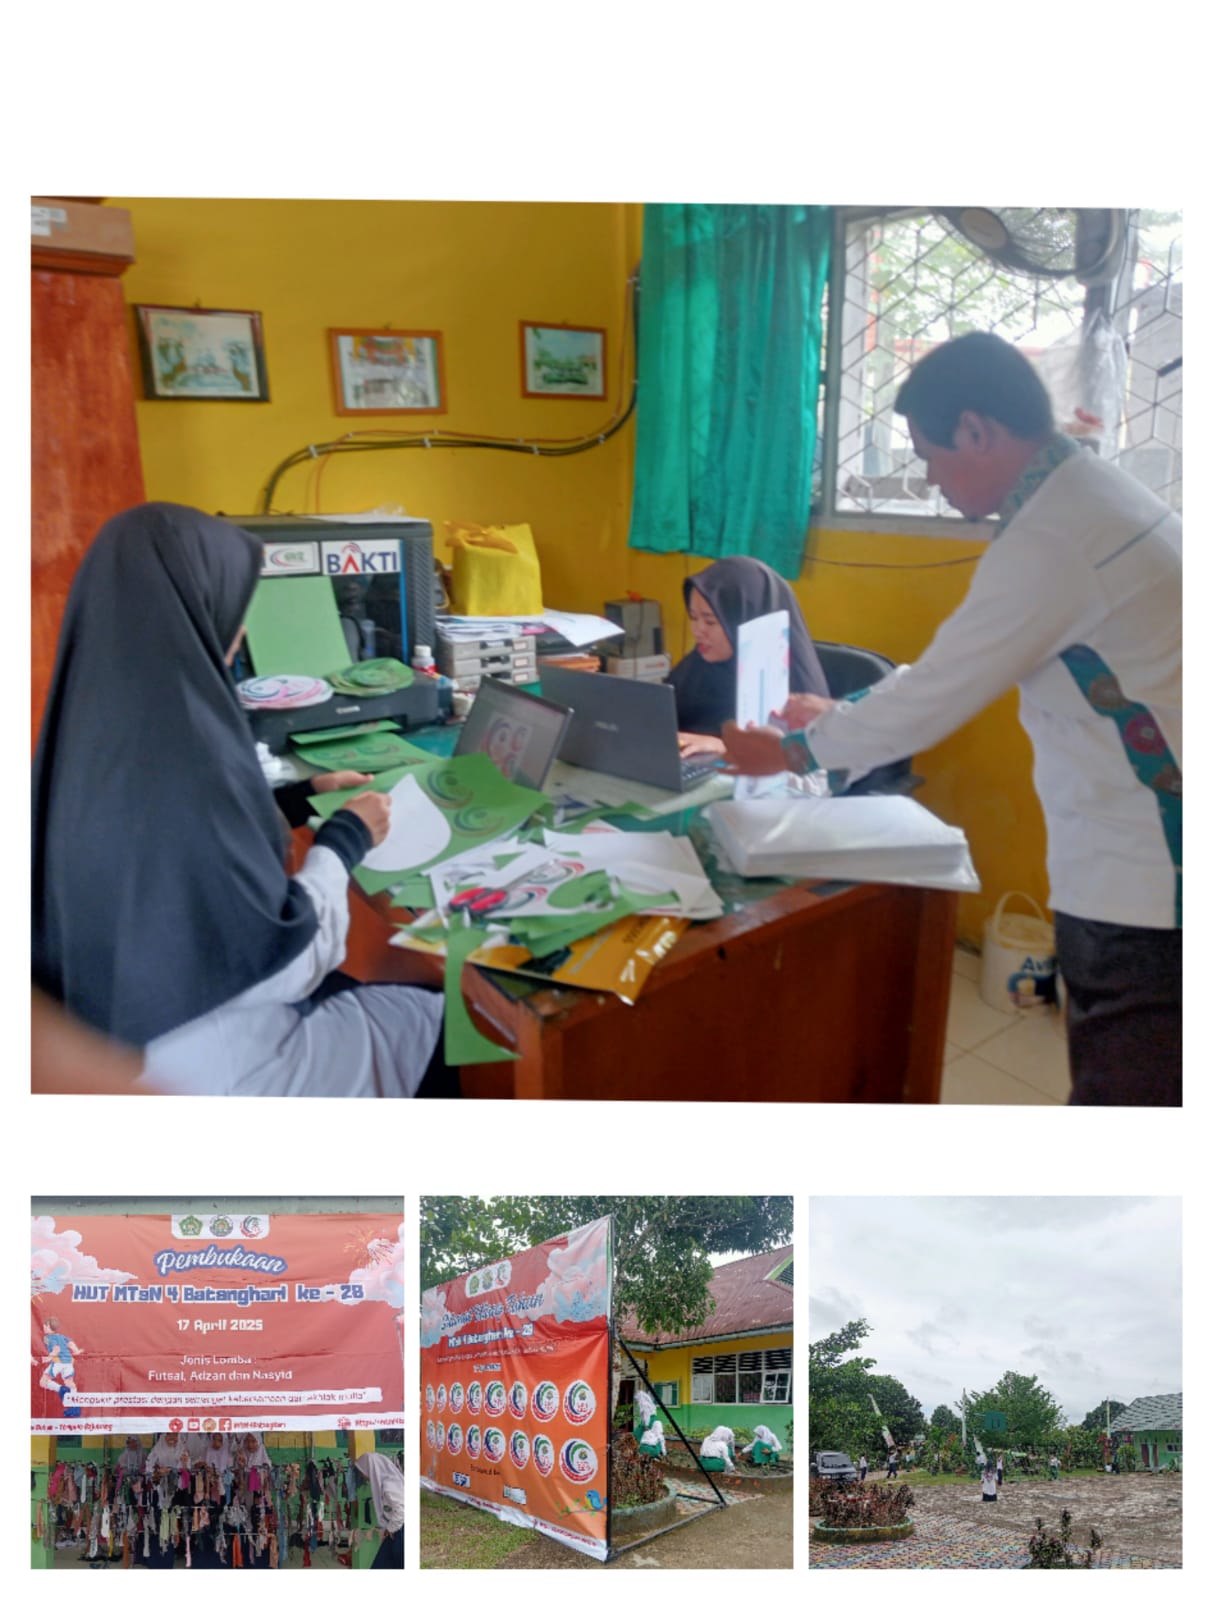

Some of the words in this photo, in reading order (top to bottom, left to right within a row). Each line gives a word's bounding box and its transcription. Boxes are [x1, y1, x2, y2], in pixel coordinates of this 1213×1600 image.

[327, 552, 397, 574] BAKTI
[155, 1245, 286, 1276] Pembukaan
[73, 1285, 110, 1300] HUT
[166, 1286, 179, 1302] 4
[297, 1284, 321, 1300] ke
[340, 1285, 364, 1300] 28
[177, 1319, 190, 1331] 17
[194, 1319, 227, 1334] April
[230, 1319, 263, 1331] 2025
[180, 1355, 210, 1366] Jenis
[148, 1370, 186, 1382] Futsal,
[229, 1371, 250, 1381] dan
[252, 1370, 293, 1382] Nasyid
